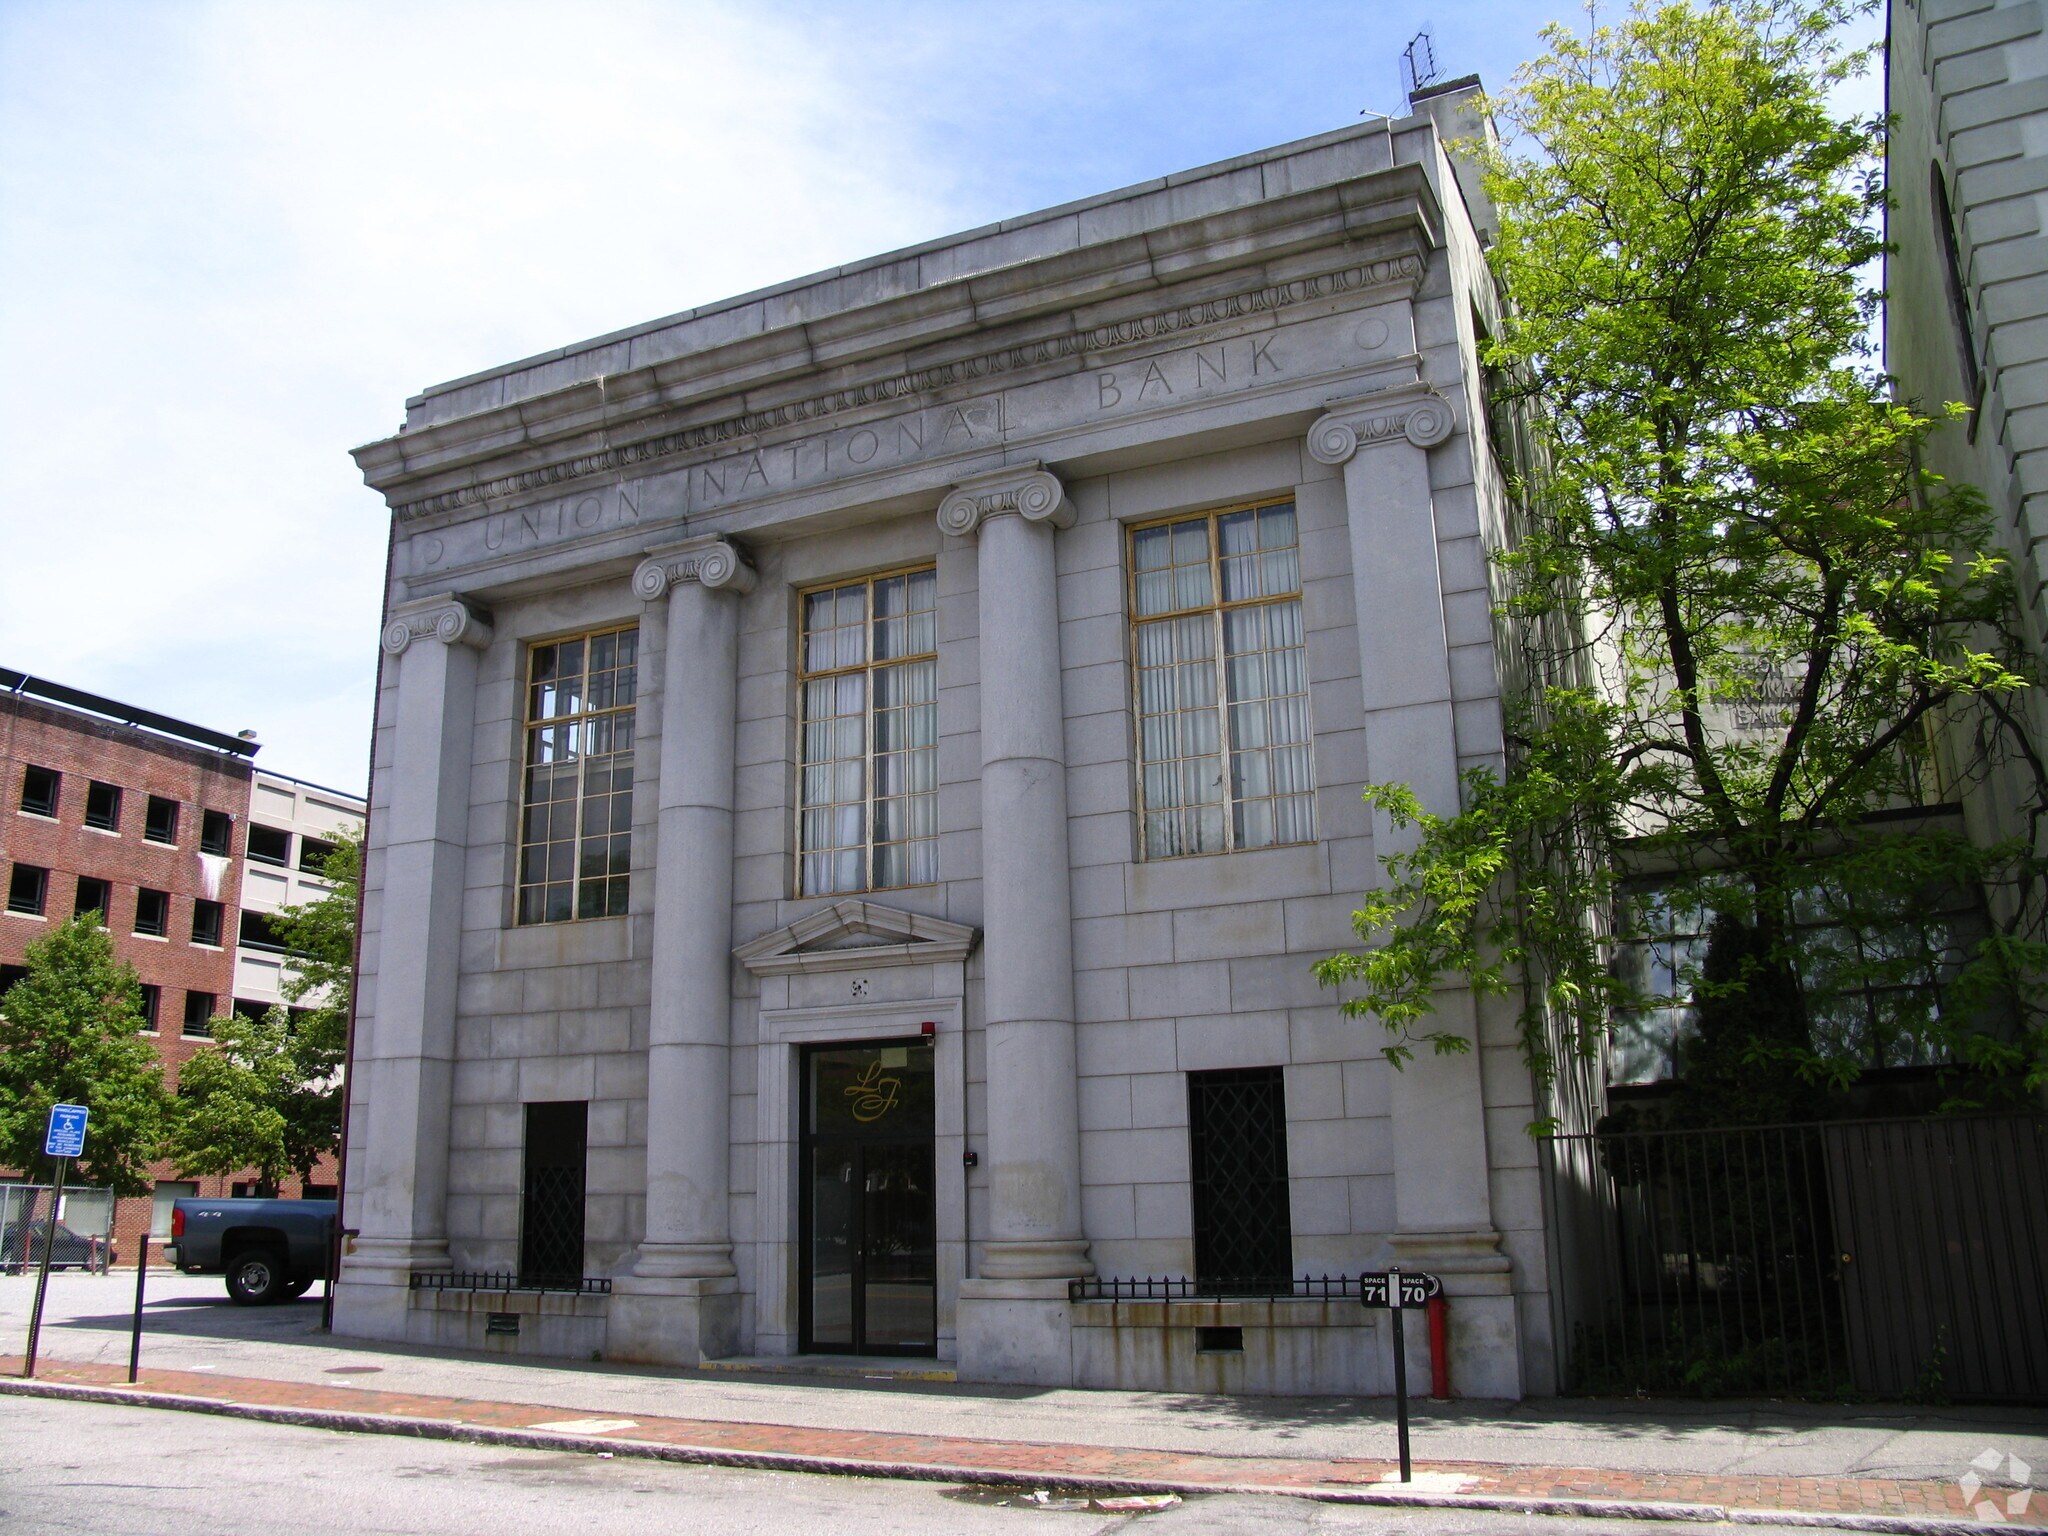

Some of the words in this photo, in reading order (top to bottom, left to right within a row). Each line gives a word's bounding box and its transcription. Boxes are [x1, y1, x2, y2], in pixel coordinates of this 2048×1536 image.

[484, 484, 642, 550] UNION
[702, 397, 1017, 501] NATIONAL
[1097, 334, 1284, 410] BANK
[1364, 1286, 1387, 1302] 71
[1401, 1286, 1426, 1303] 70
